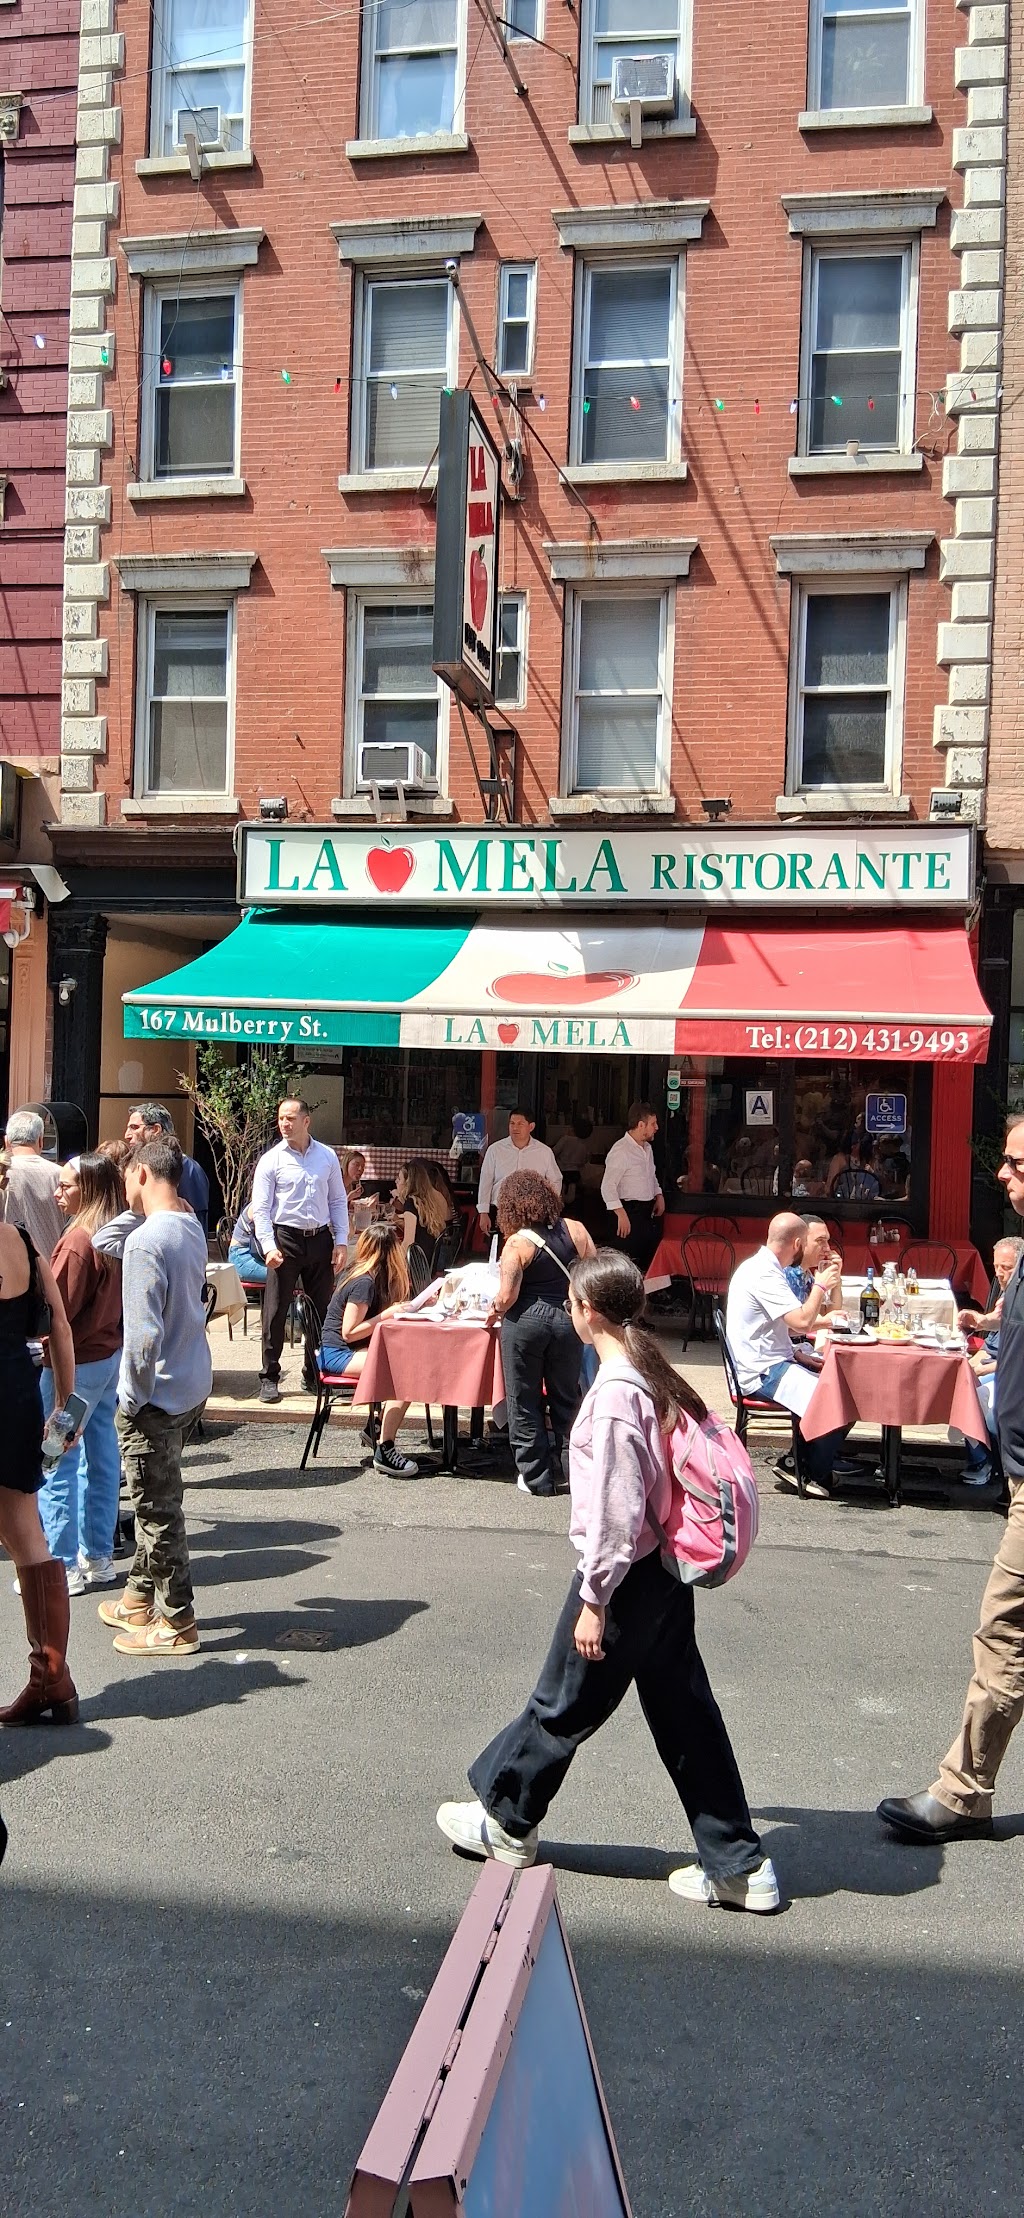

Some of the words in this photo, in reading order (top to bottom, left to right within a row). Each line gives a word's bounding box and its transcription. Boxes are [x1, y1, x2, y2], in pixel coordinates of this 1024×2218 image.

[469, 446, 487, 491] LA
[264, 838, 348, 892] LA
[433, 838, 626, 892] MELA
[652, 852, 952, 891] RISTORANTE
[140, 1009, 178, 1030] 167
[182, 1010, 294, 1041] Mulberry
[298, 1015, 329, 1037] St.
[444, 1018, 488, 1043] LA
[531, 1020, 632, 1047] MELA
[861, 1028, 970, 1054] 431-9493
[751, 1096, 768, 1114] A
